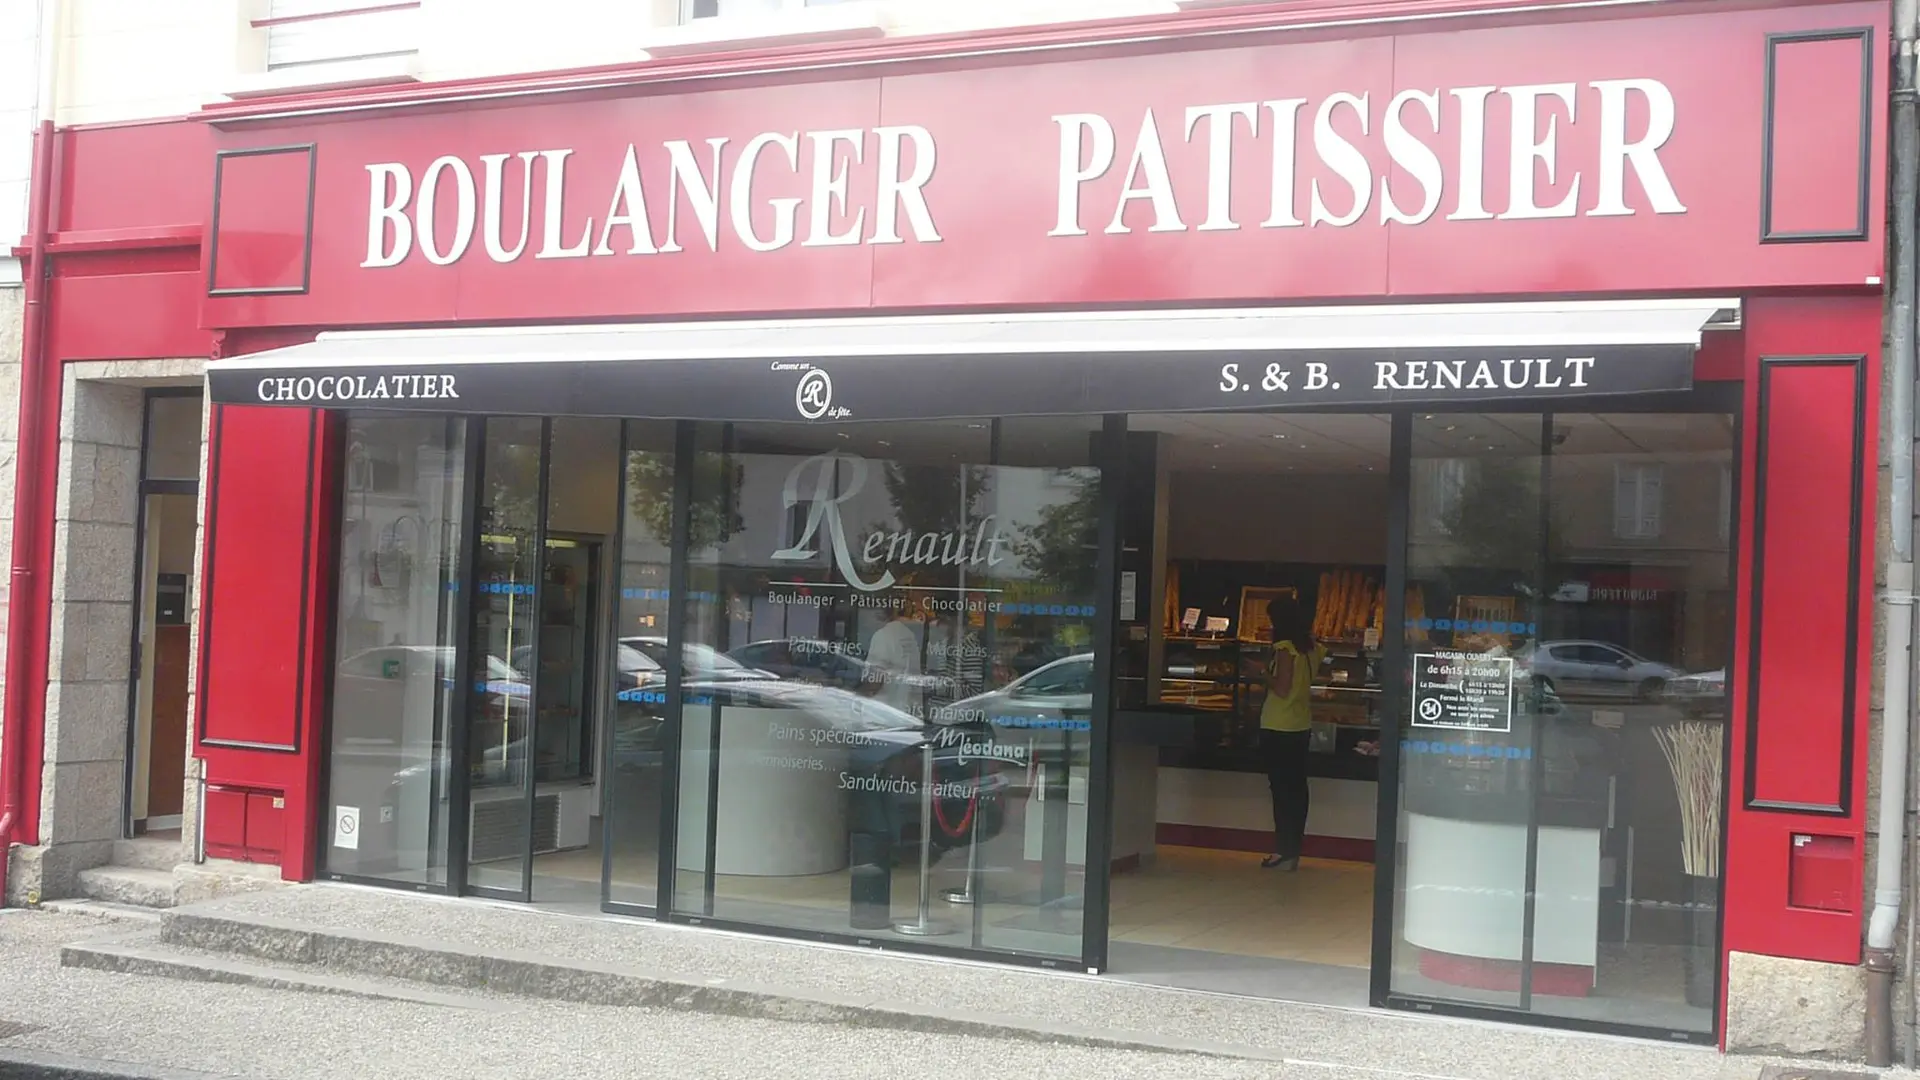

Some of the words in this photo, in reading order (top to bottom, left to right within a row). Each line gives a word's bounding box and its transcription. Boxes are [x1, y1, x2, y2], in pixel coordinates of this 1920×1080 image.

[360, 125, 944, 269] BOULANGER
[1047, 78, 1688, 237] PATISSIER
[771, 361, 799, 371] Comme
[1219, 363, 1250, 392] S.
[1261, 362, 1290, 392] &
[1303, 362, 1341, 391] B.
[1373, 356, 1595, 390] RENAULT
[257, 374, 460, 401] CHOCOLATIER
[801, 380, 824, 407] R
[828, 407, 837, 417] de
[770, 448, 1005, 592] Renault
[768, 591, 835, 607] Boulanger
[850, 594, 907, 609] Pâtissier
[922, 596, 1003, 613] Chocolatier
[1435, 651, 1466, 660] MAGASIN
[1466, 652, 1491, 661] OUVERT
[860, 669, 892, 685] Pains
[1427, 664, 1438, 674] de
[1440, 665, 1462, 675] 6h15
[1464, 667, 1470, 675] à
[1472, 667, 1500, 677] 20h00
[768, 722, 805, 742] Pains
[932, 727, 1025, 766] Méodana
[838, 771, 917, 795] Sandwichs
